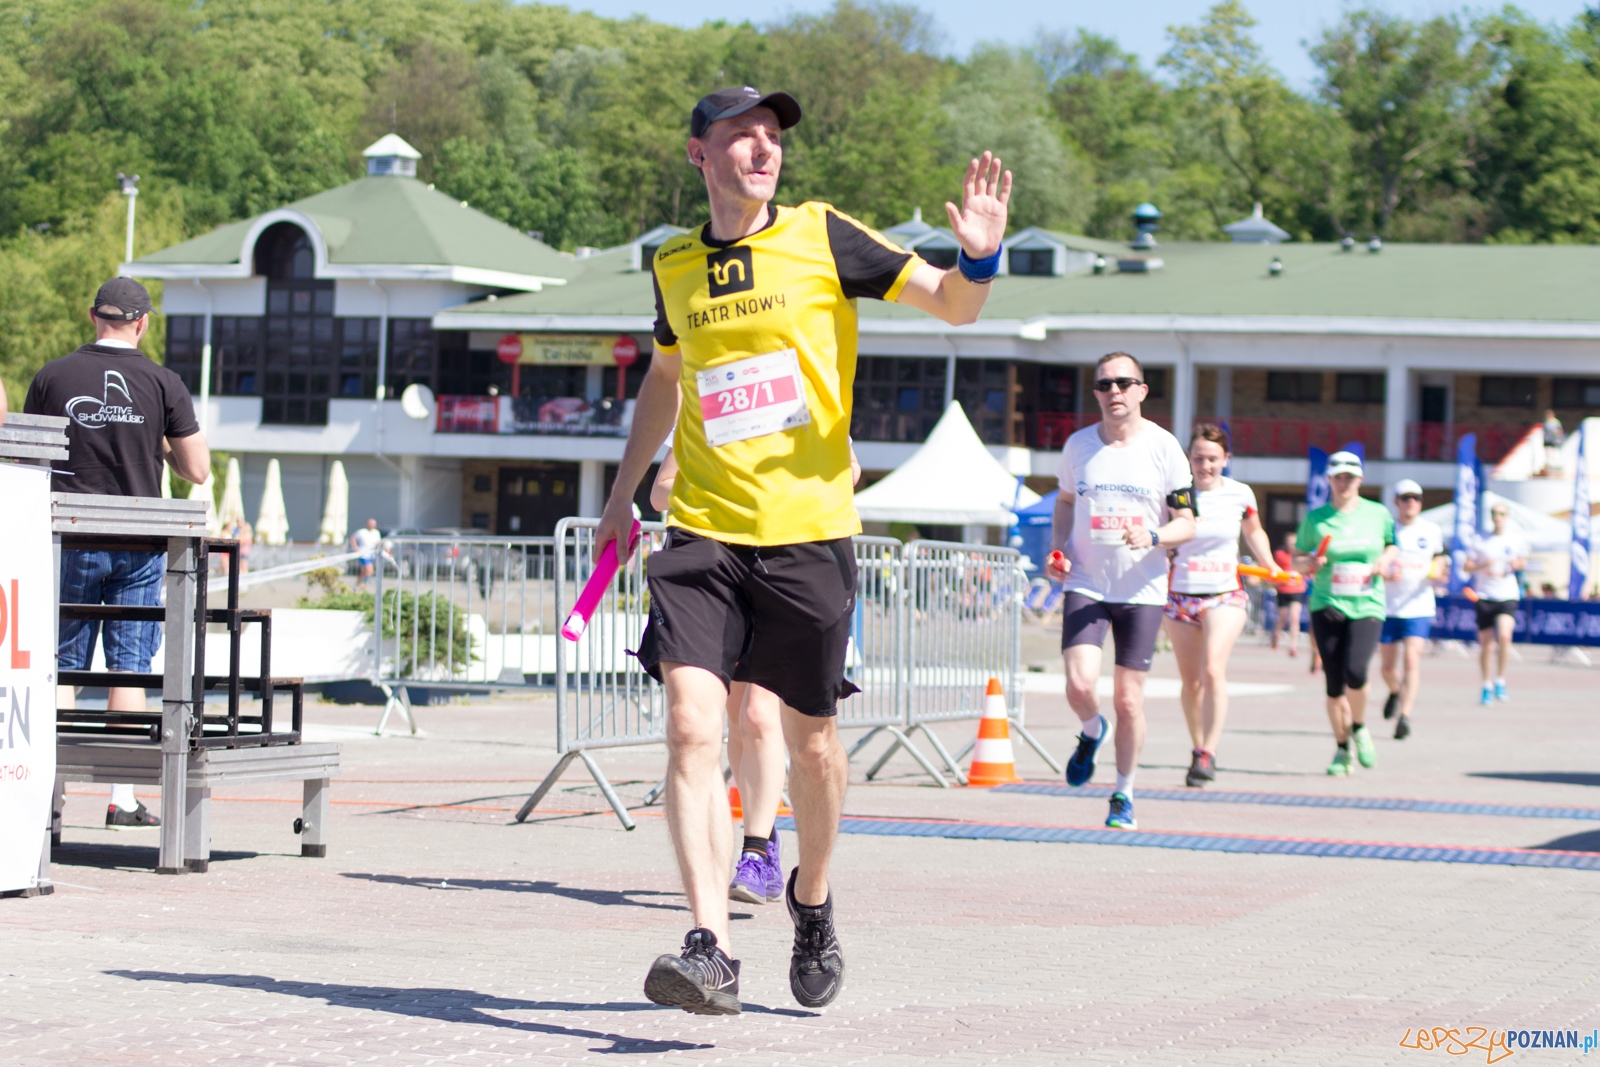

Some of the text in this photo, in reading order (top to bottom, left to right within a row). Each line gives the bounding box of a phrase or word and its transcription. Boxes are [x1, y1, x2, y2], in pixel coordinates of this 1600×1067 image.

[687, 306, 730, 330] TEATR
[718, 381, 775, 415] 28/1
[98, 406, 133, 415] ACTIVE
[1095, 483, 1153, 496] MEDICOVER
